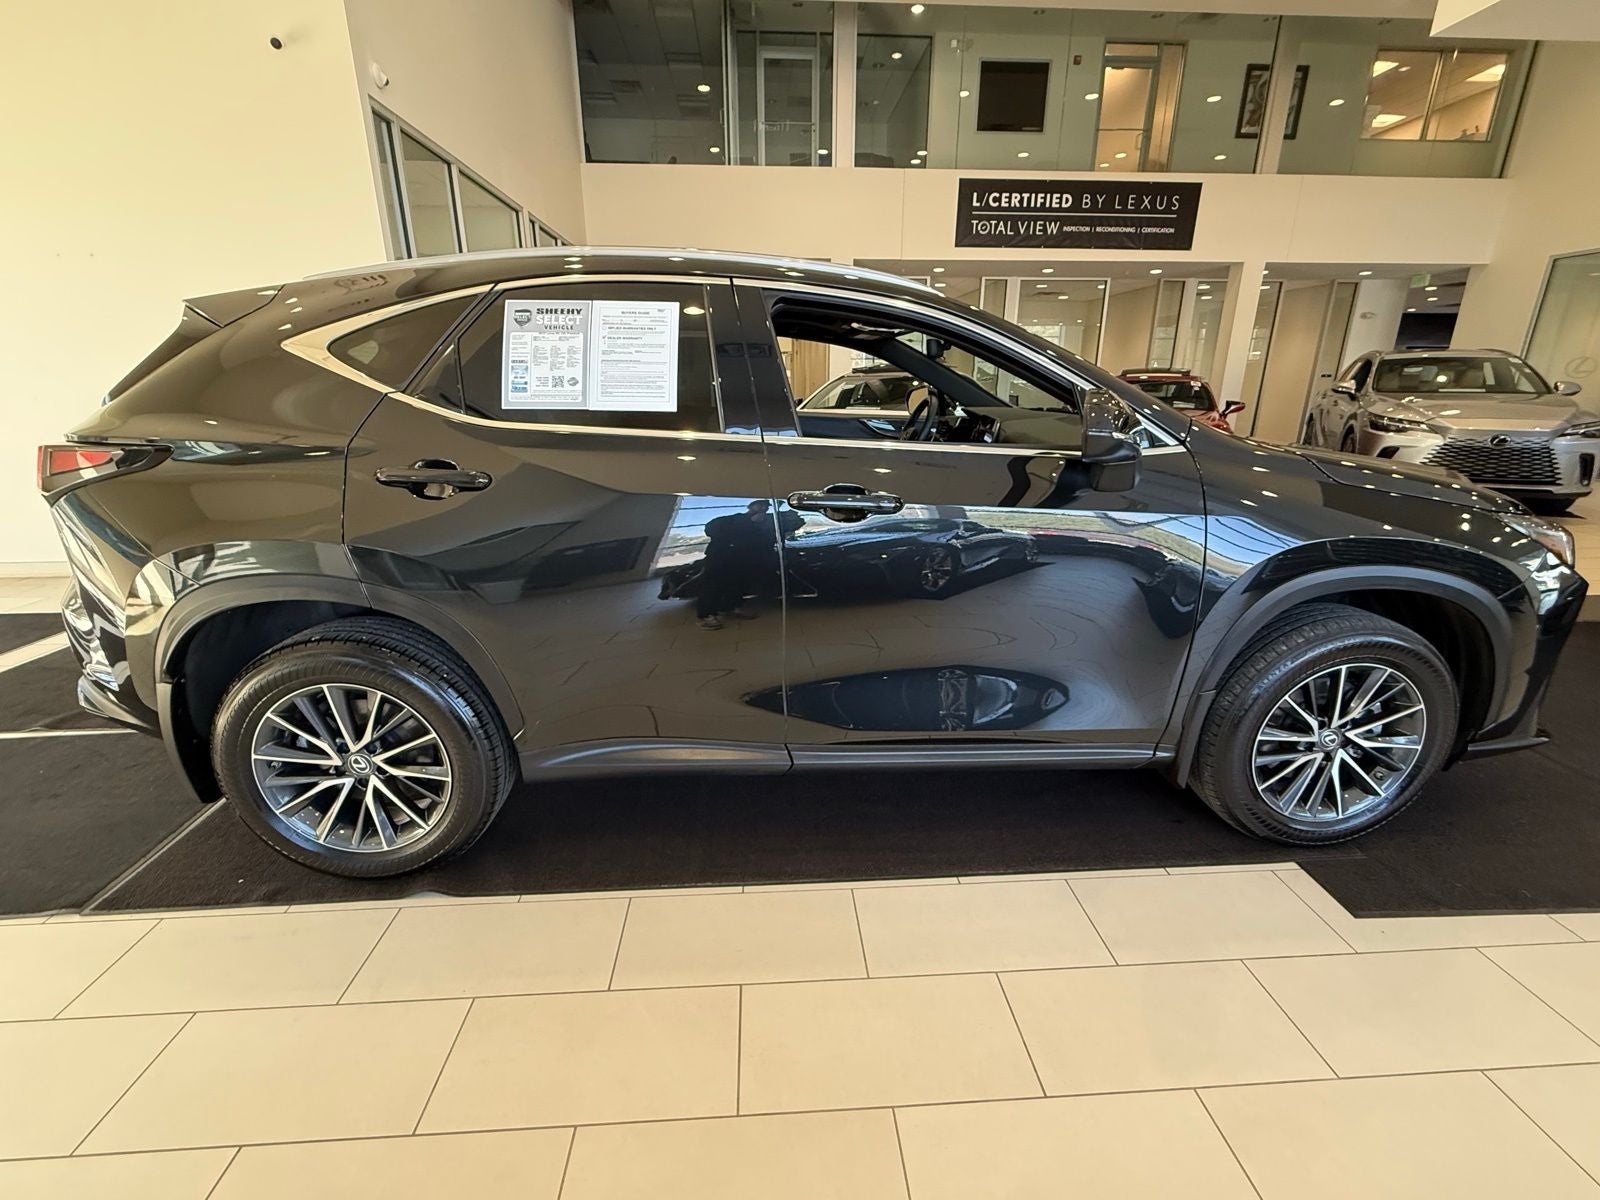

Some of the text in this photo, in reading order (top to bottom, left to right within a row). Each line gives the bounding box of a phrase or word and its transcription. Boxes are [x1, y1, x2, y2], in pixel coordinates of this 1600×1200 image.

[972, 192, 1180, 210] L/CERTIFIED BY LEXUS
[971, 220, 1060, 235] TOTAL VIEW
[536, 315, 583, 325] SELECT
